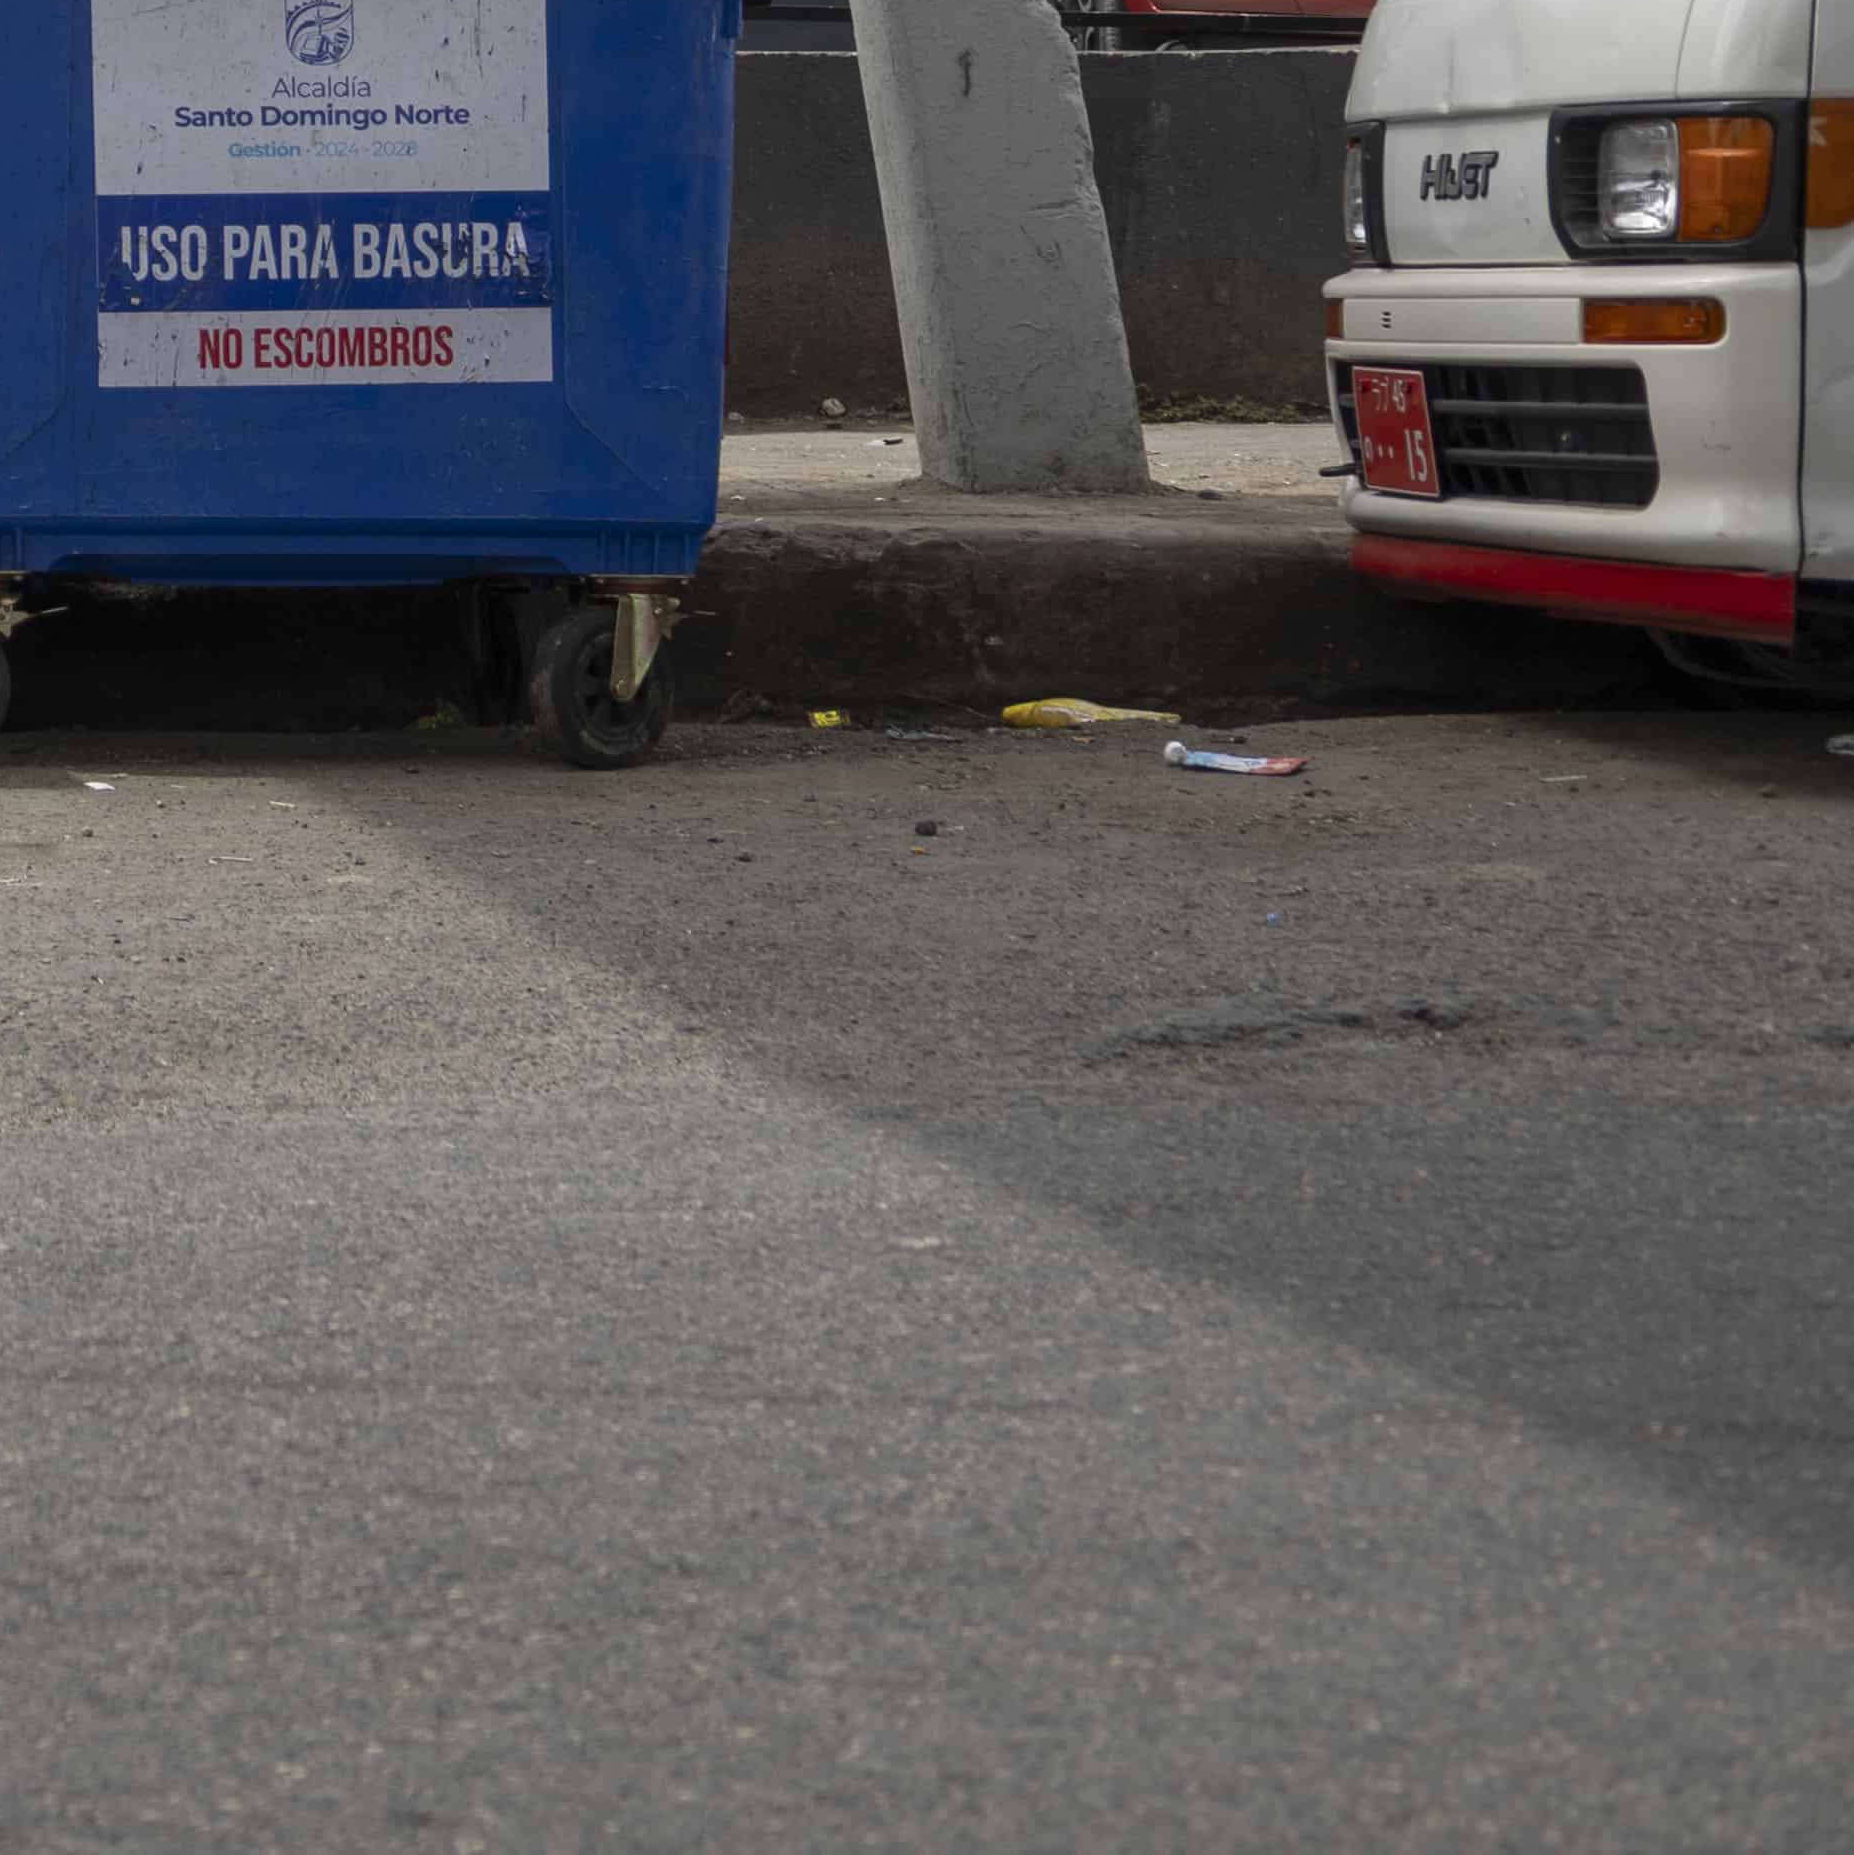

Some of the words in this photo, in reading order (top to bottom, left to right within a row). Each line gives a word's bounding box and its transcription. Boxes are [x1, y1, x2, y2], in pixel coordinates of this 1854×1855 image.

[271, 76, 372, 99] Alcaldía
[174, 105, 253, 128] Santo
[261, 103, 387, 131] Domingo
[395, 104, 470, 127] Norte
[228, 141, 301, 158] Gestión
[314, 142, 360, 158] 2024
[372, 140, 419, 157] 2028
[120, 225, 208, 282] USO
[223, 224, 339, 281] PARA
[353, 221, 530, 279] BASURA
[198, 328, 243, 370] NO
[254, 325, 454, 369] ESCOMBROS
